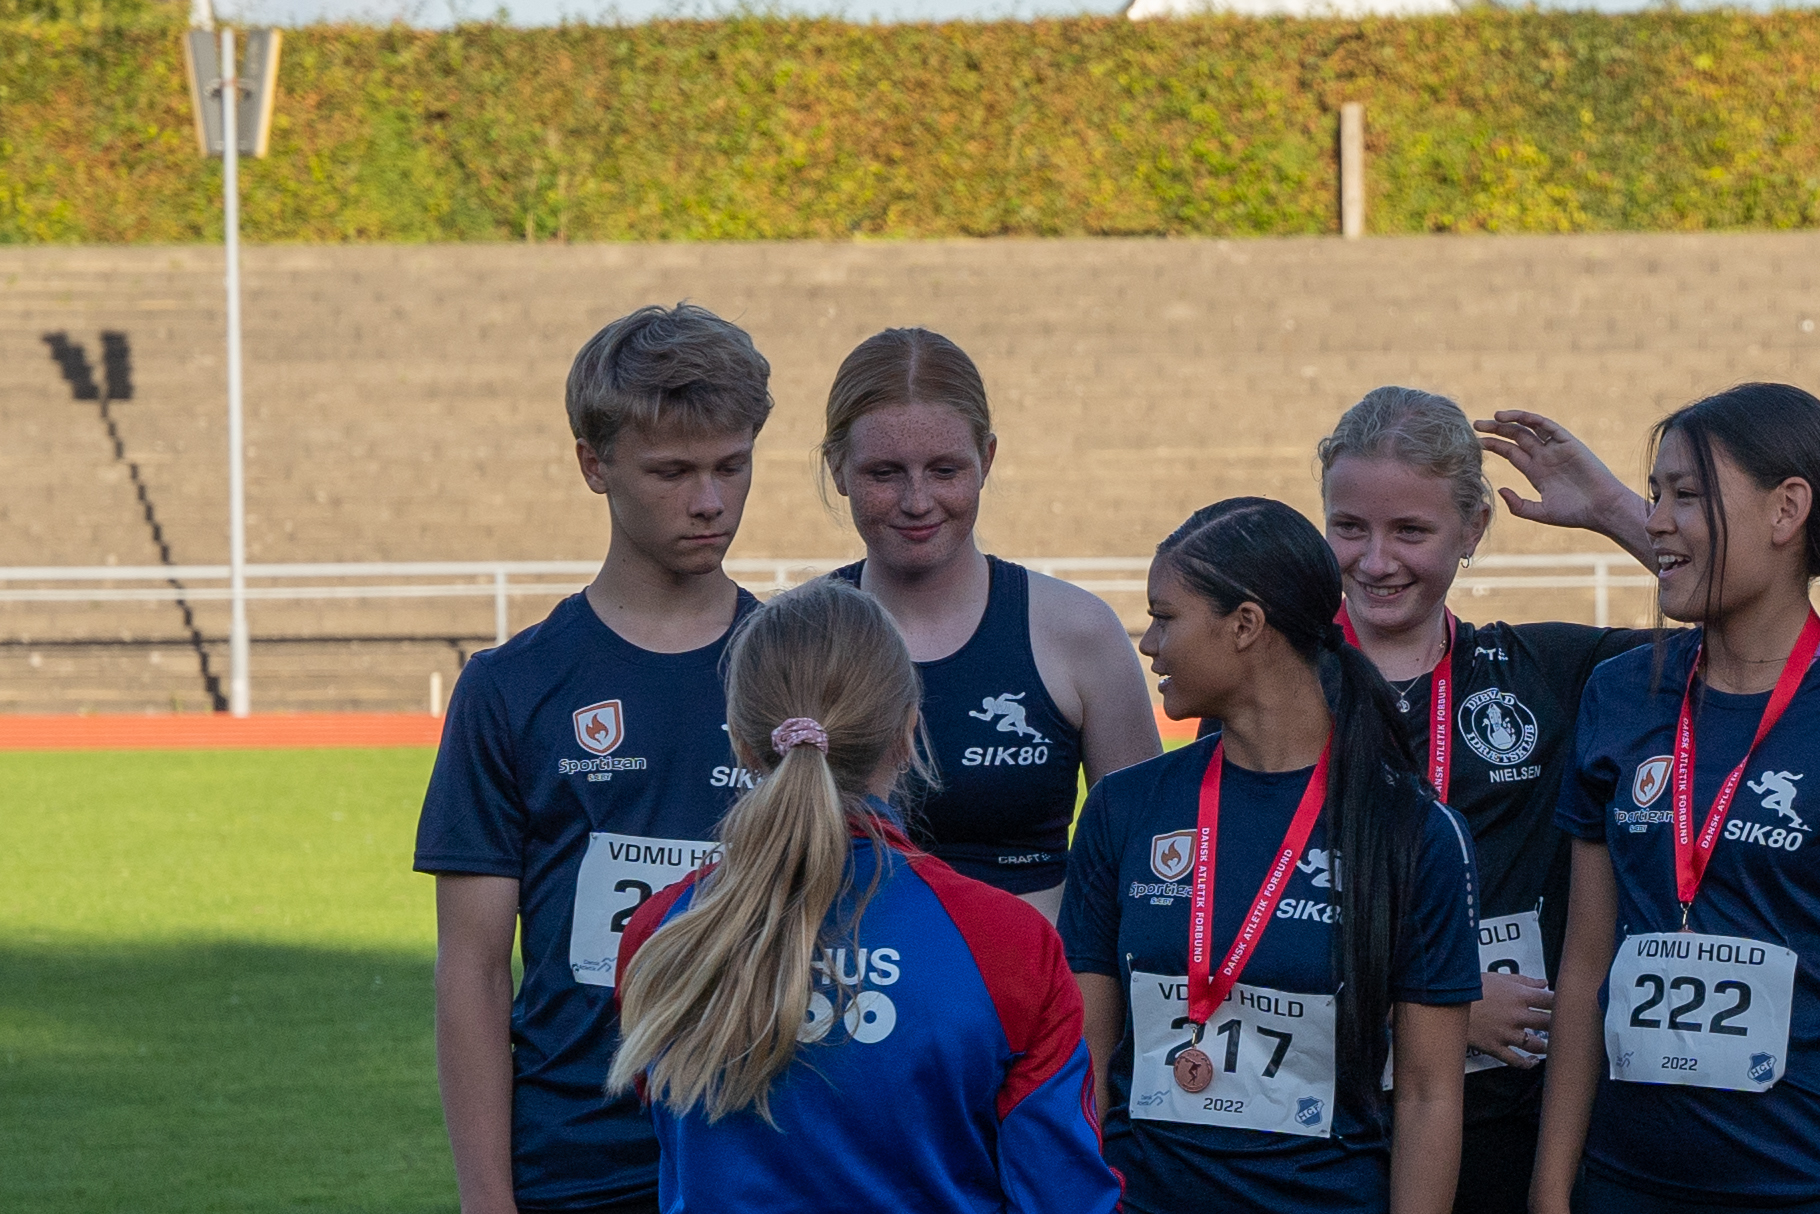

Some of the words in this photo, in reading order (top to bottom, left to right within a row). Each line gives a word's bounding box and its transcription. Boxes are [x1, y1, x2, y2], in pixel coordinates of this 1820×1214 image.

[1437, 678, 1446, 721] FORBUND
[1681, 717, 1690, 749] DANSK
[558, 755, 647, 775] Sportigan
[961, 745, 1049, 766] SIK80
[1678, 751, 1689, 791] ATLETIK
[710, 766, 764, 789] SIK
[1434, 765, 1444, 798] ANSK
[1489, 764, 1542, 784] NIELSEN
[1678, 794, 1689, 845] FORBUND
[1701, 813, 1722, 849] DANSK
[1723, 819, 1803, 851] SIK80
[608, 841, 683, 867] VDMU
[998, 853, 1040, 864] CRAFT
[1199, 827, 1210, 862] DANSK
[1196, 865, 1207, 908] ATLETIK
[1223, 941, 1248, 977] DANSK
[1243, 898, 1269, 941] ATLETIK
[1263, 848, 1293, 897] FORBUND
[1276, 898, 1343, 924] SIK8
[1193, 912, 1205, 963] FORBUND
[1478, 922, 1521, 946] OLD
[810, 947, 901, 986] HUS
[1636, 939, 1691, 959] VDMU
[1697, 942, 1766, 966] HOLD
[1158, 983, 1232, 1003] VD
[1239, 990, 1304, 1018] HOLD
[1629, 973, 1752, 1037] 222
[1164, 1016, 1293, 1079] 217
[1660, 1056, 1698, 1072] 2022
[1203, 1097, 1245, 1114] 2022
